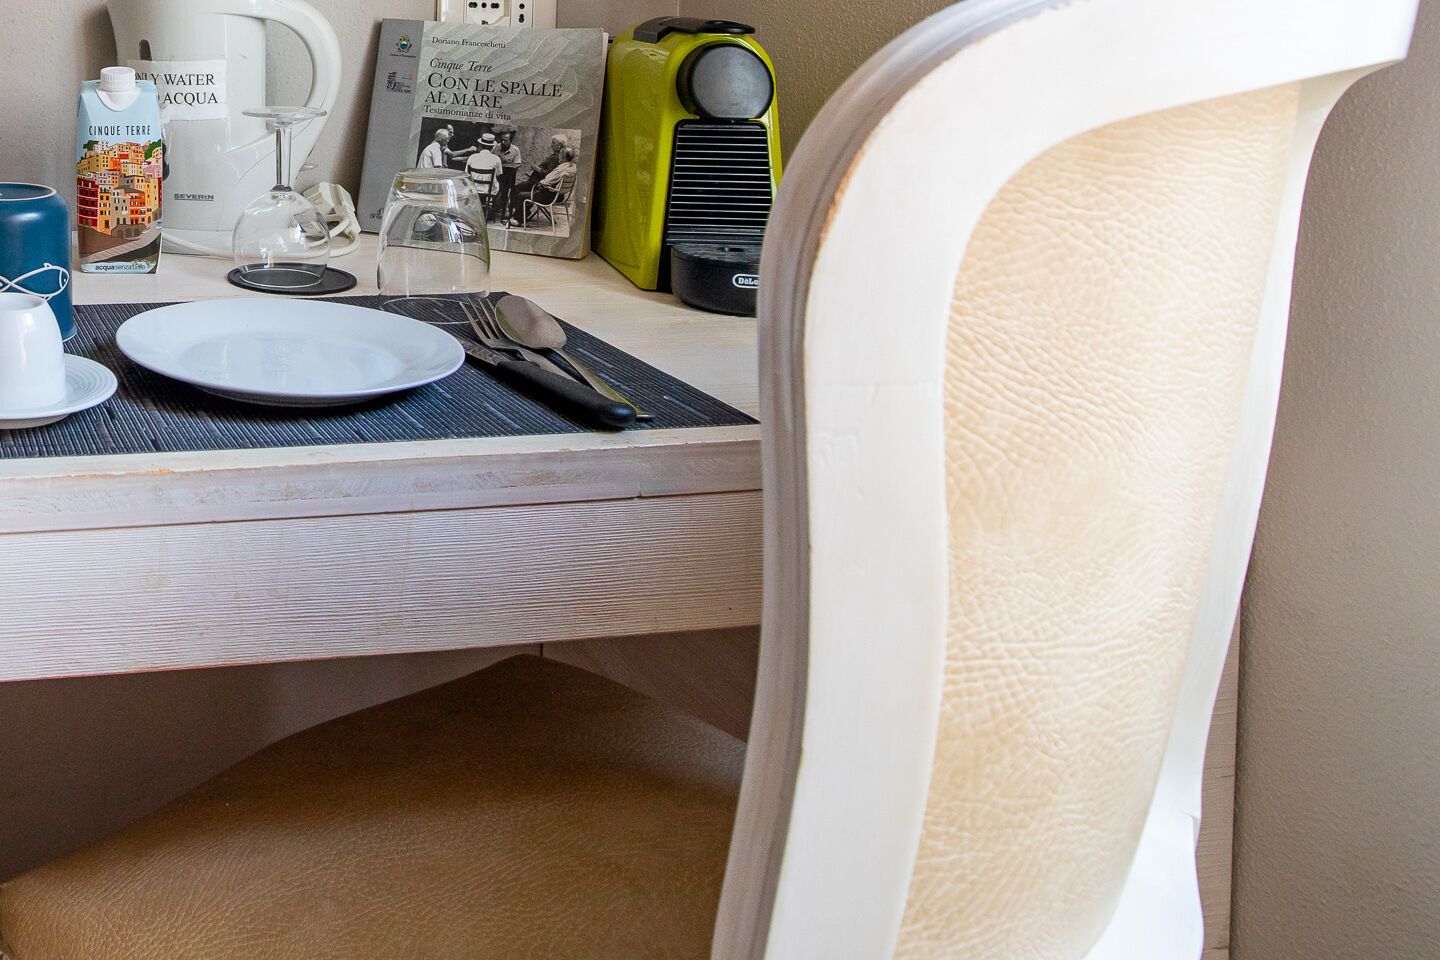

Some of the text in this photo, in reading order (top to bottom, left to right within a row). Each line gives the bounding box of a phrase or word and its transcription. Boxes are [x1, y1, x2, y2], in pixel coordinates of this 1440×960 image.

[432, 36, 506, 49] Doriano Franceschetti
[429, 57, 493, 73] Cinque Terre
[135, 72, 216, 86] NLY WATER
[427, 72, 470, 90] CON
[475, 79, 495, 93] LE
[500, 80, 562, 97] SPALLE
[163, 92, 219, 106] ACQUA
[425, 90, 503, 109] AL MARE
[423, 105, 512, 121] Testimonianze di vita
[88, 125, 151, 136] CINQUE TERRE
